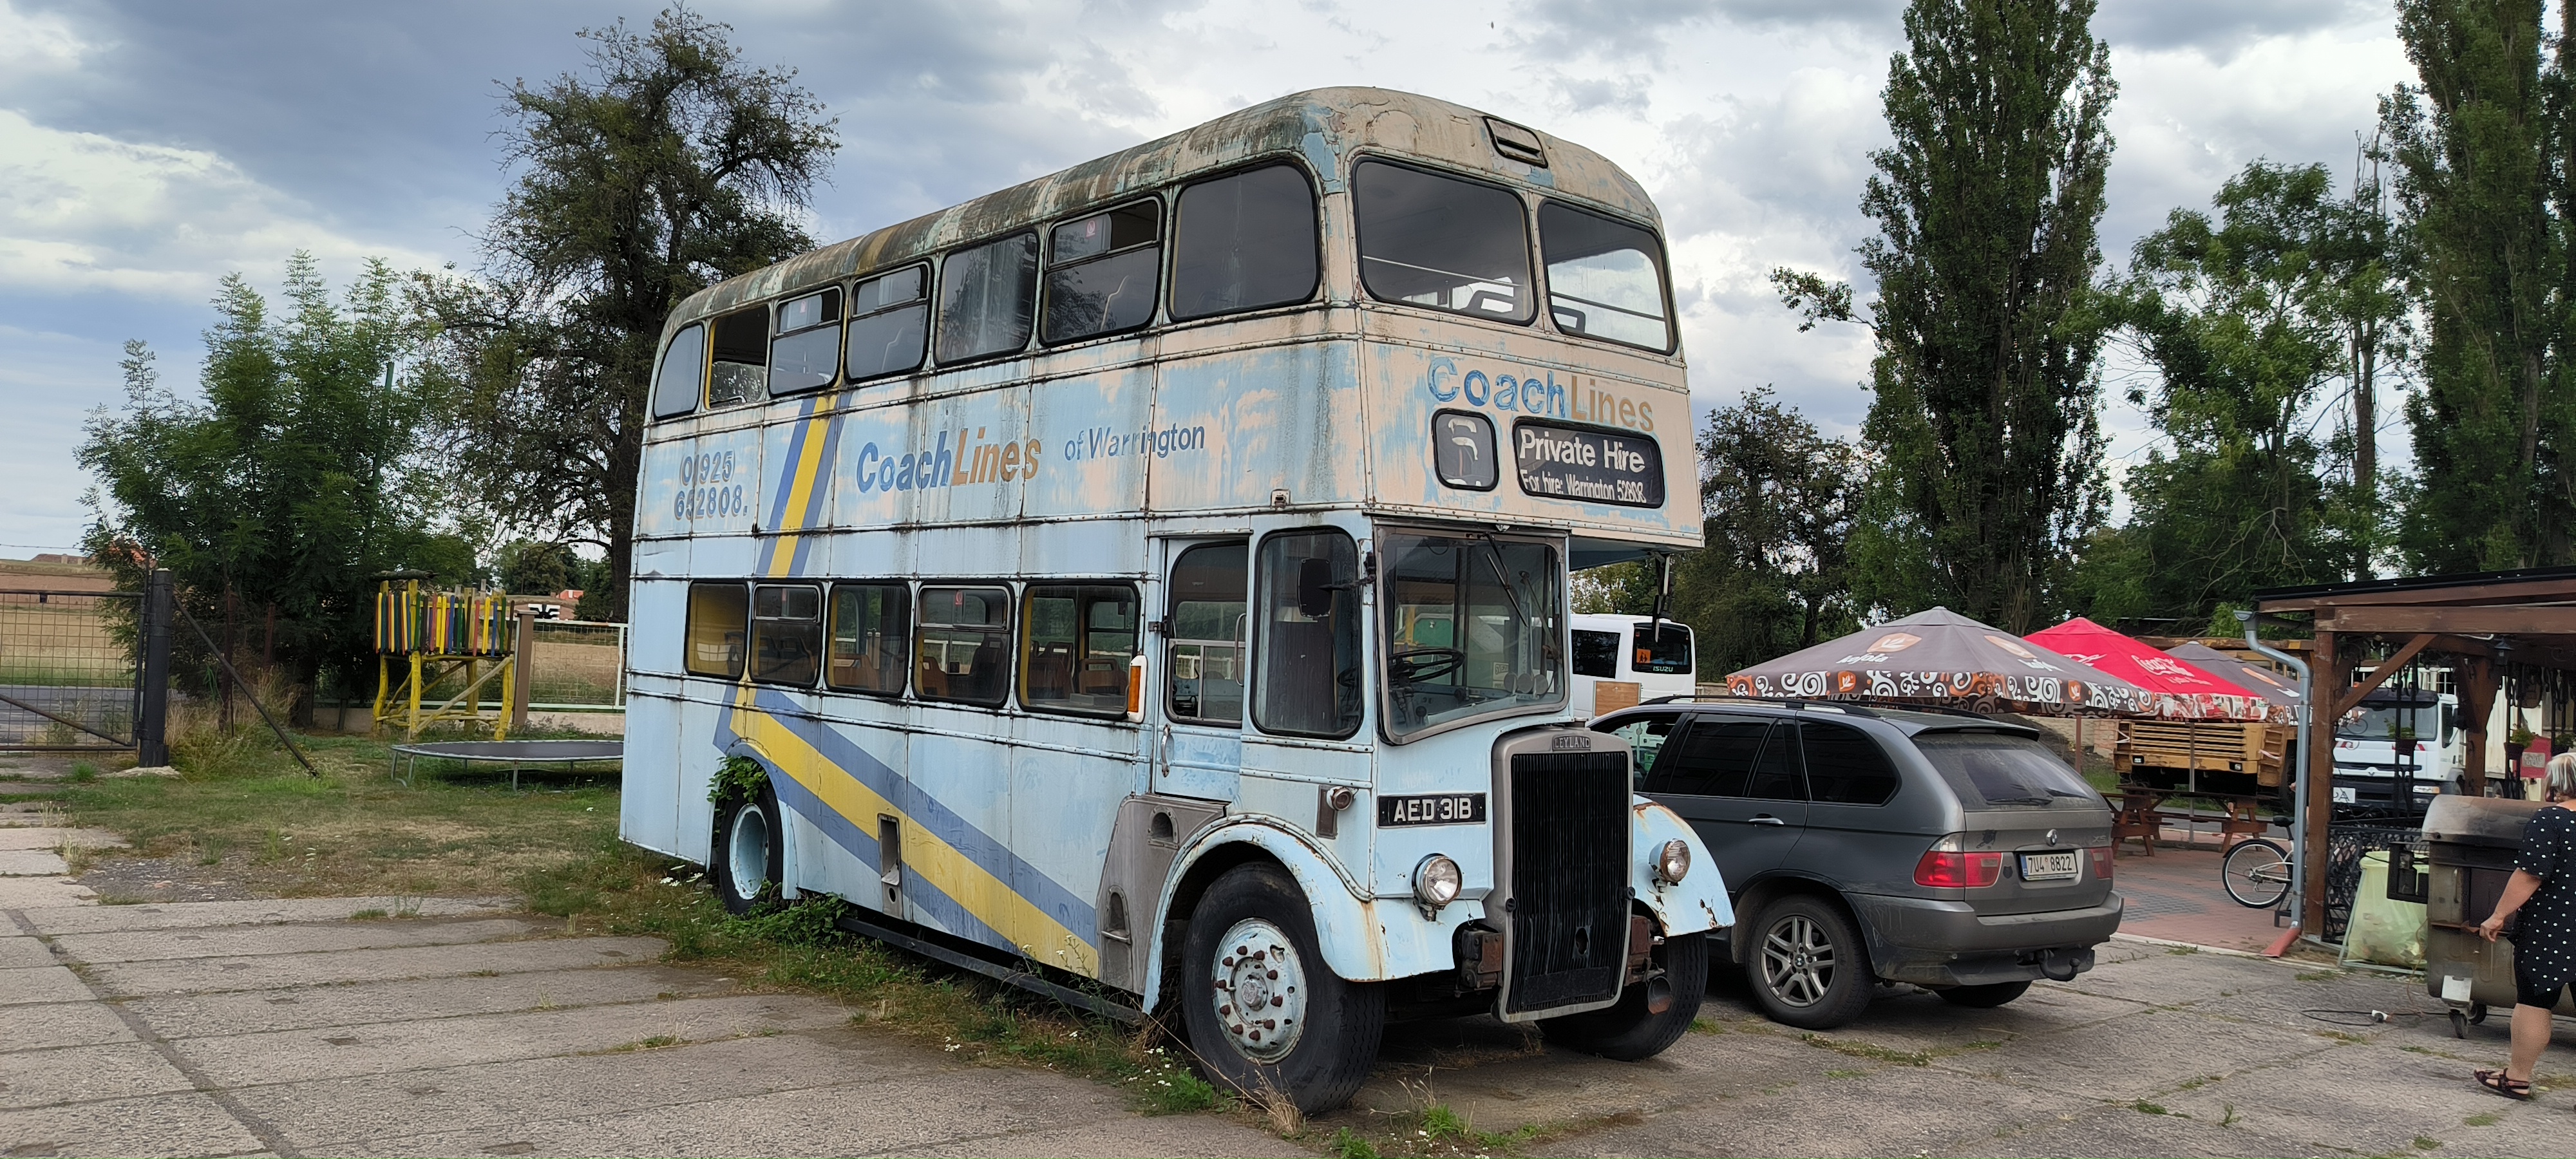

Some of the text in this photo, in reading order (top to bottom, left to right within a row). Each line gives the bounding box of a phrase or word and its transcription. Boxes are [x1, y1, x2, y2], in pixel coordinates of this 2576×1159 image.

[1427, 357, 1654, 432] CoachLines
[1064, 422, 1206, 460] of Warrington
[1520, 429, 1596, 467] Private
[1604, 439, 1645, 473] Hire
[857, 426, 1041, 493] CoachLines
[1520, 469, 1647, 504] For hire: Warrington 52808
[1554, 737, 1590, 748] LEYLAND
[1393, 798, 1472, 822] AED 31B
[2028, 856, 2045, 873] 7U4
[2050, 856, 2072, 872] 8822
